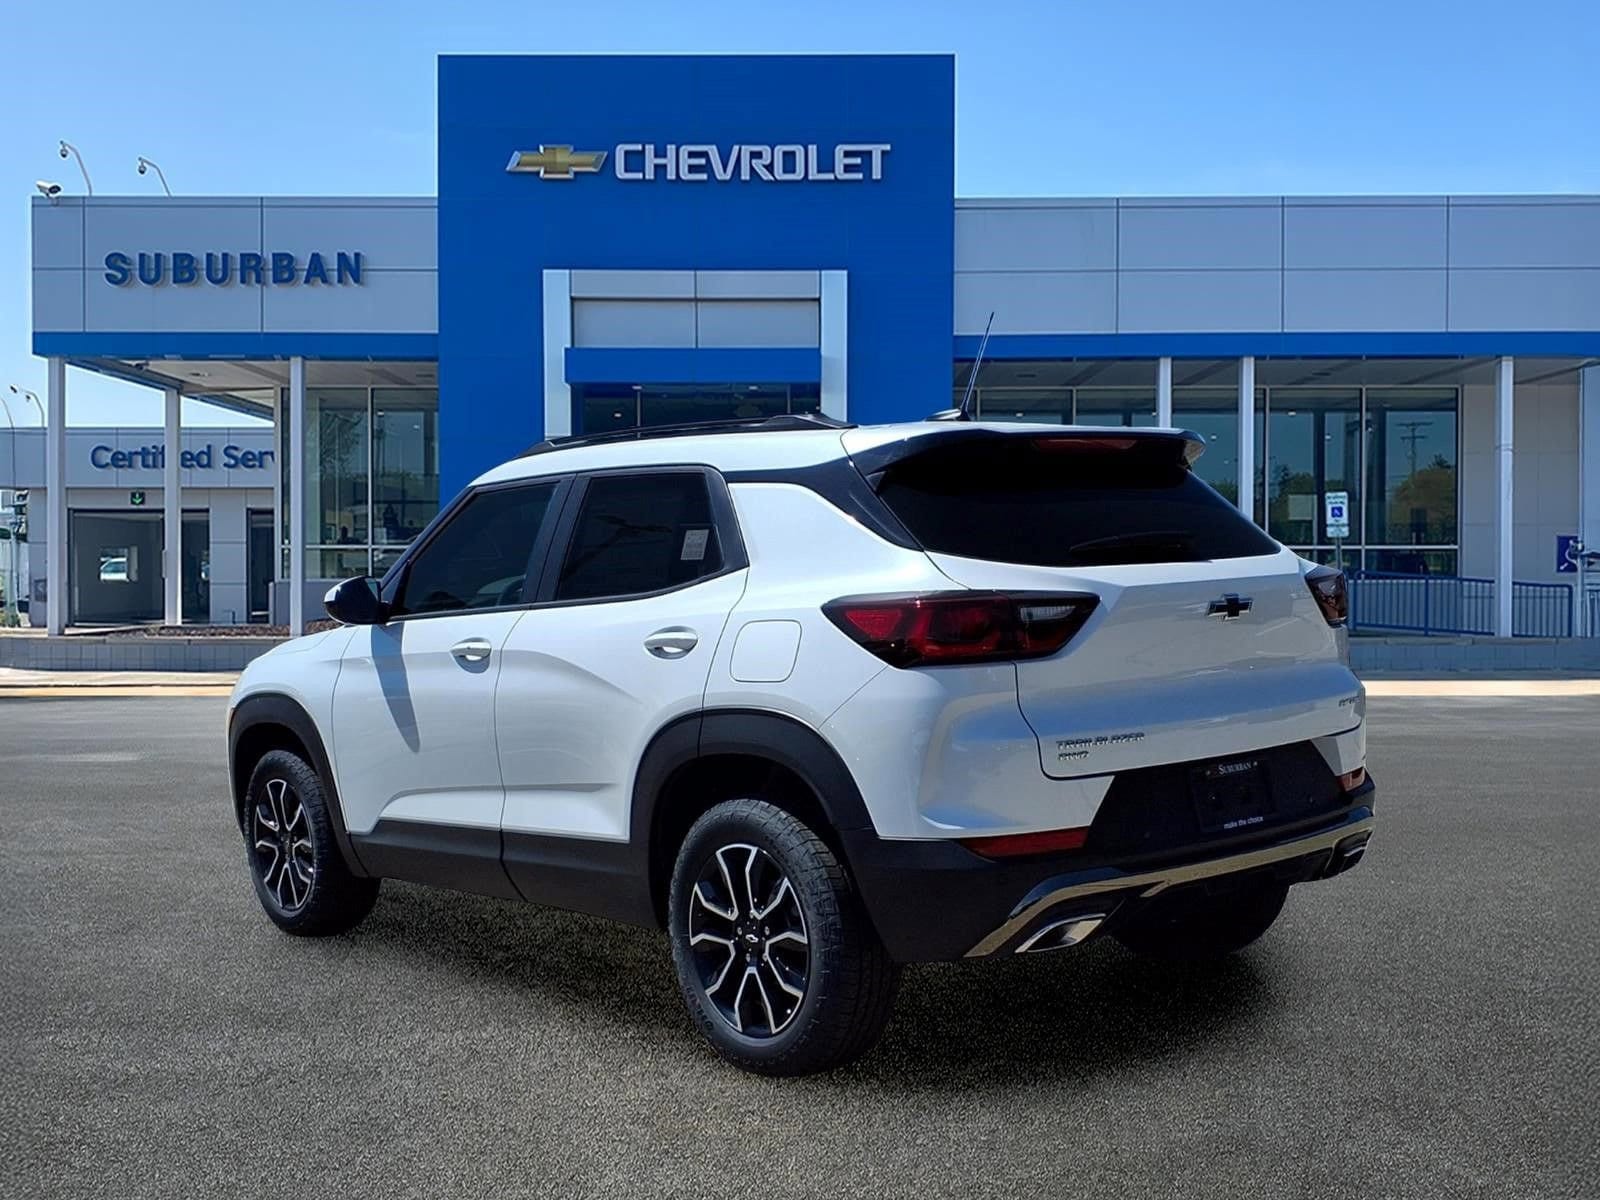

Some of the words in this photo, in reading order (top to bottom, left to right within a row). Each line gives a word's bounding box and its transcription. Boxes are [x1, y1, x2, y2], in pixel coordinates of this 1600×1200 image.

[615, 144, 891, 181] CHEVROLET
[104, 252, 361, 285] SUBURBAN
[91, 444, 213, 470] Certifed
